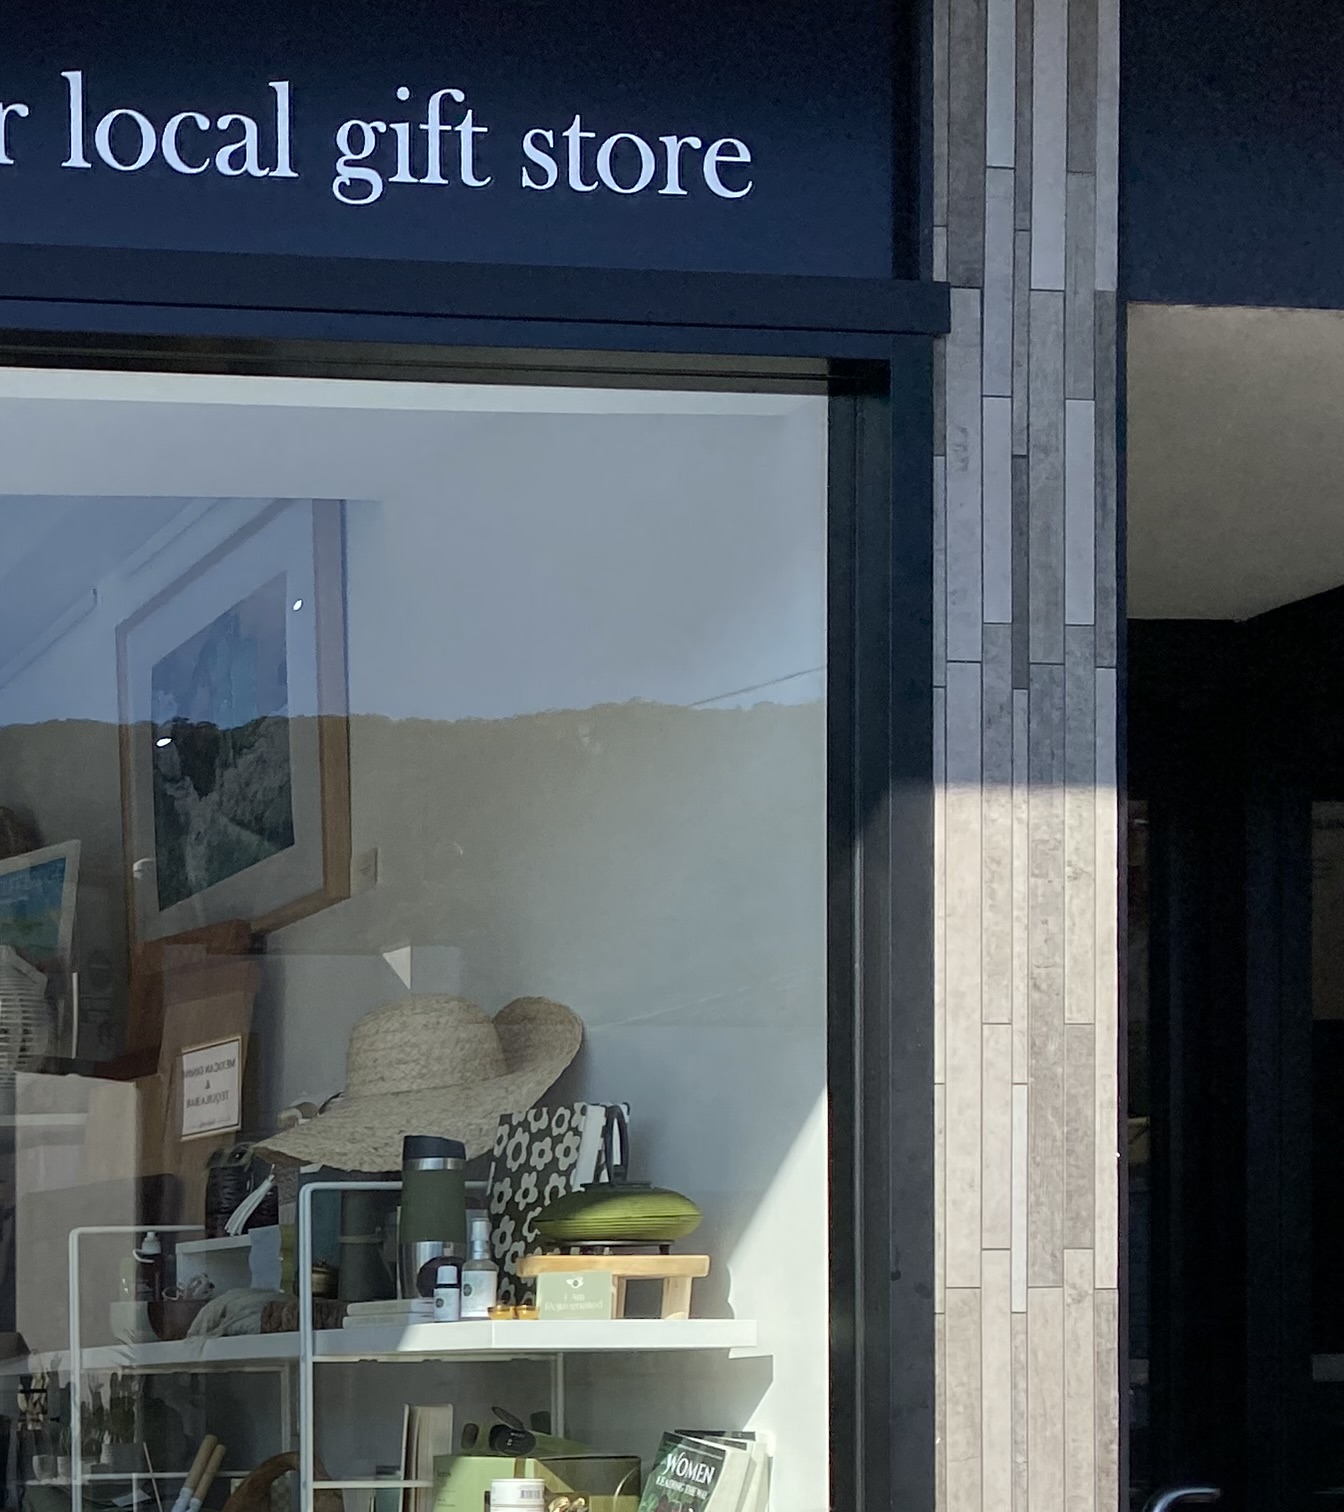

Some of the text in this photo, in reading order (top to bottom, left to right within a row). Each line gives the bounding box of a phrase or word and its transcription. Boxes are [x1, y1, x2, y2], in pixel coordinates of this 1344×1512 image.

[60, 70, 299, 178] local
[332, 86, 492, 205] gift
[521, 114, 753, 199] store
[661, 1451, 715, 1485] WOMEN
